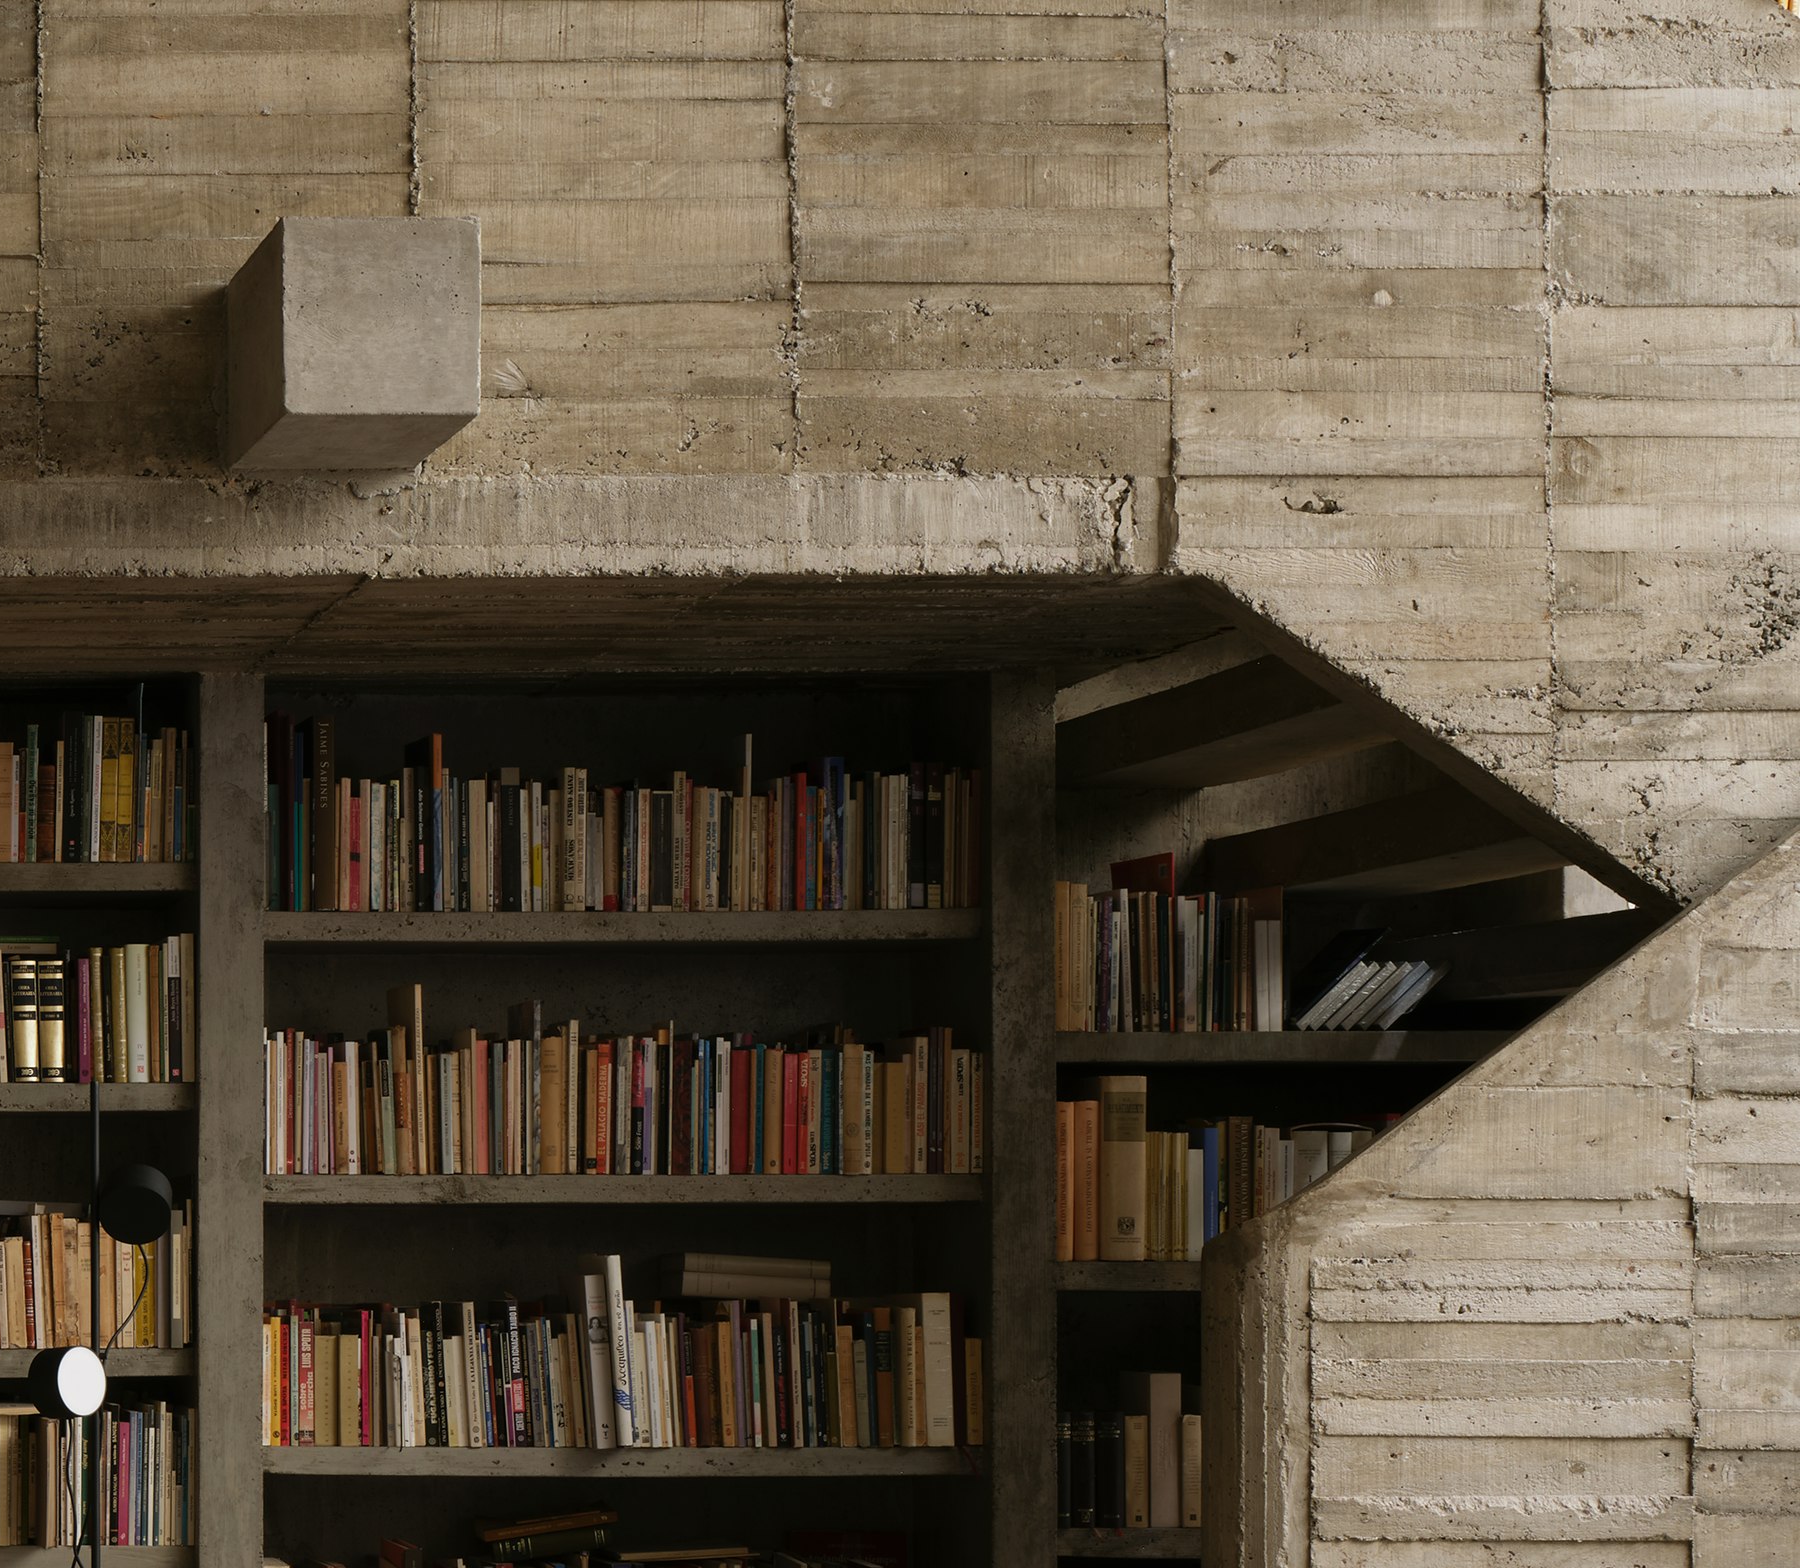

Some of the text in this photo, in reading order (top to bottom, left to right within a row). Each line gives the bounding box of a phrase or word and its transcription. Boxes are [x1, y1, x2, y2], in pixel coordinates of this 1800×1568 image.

[319, 722, 329, 808] JAIME SABINES
[800, 1059, 808, 1087] SPOTA
[599, 1065, 608, 1155] EL PALACIO MADERNA
[509, 1313, 518, 1331] TAIBO
[300, 1329, 311, 1368] LUIS SPOTA
[510, 1333, 519, 1358] IGNACIO
[512, 1360, 520, 1373] PACO
[515, 1413, 525, 1431] CUENTOS
